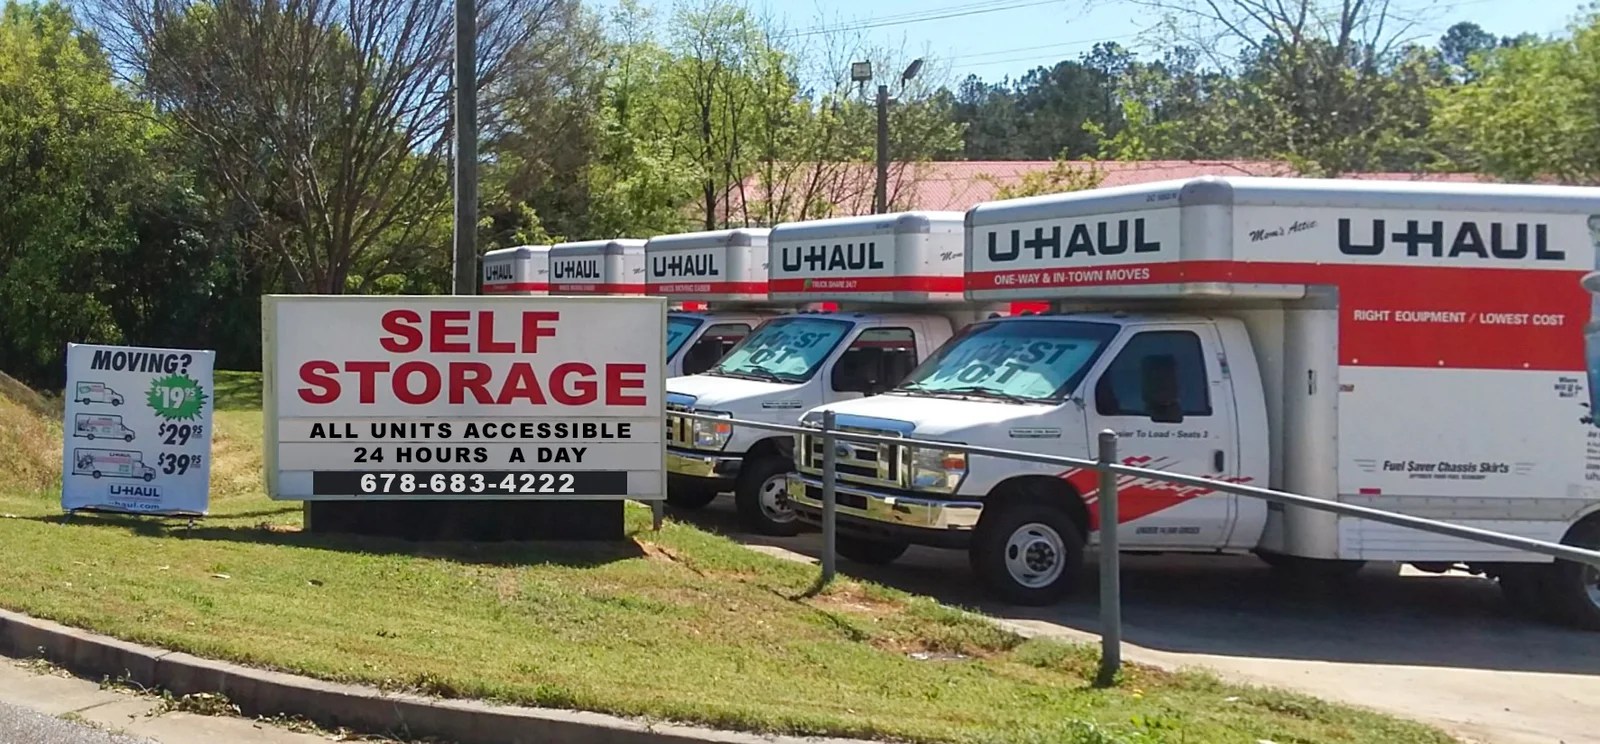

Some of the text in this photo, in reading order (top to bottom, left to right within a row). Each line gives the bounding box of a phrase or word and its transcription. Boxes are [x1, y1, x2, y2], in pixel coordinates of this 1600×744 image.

[988, 218, 1160, 262] U-HAUL
[1338, 218, 1565, 260] U-HAUL
[653, 254, 719, 277] U-HAUL
[782, 242, 883, 272] U-HAUL
[485, 263, 513, 281] U-HAUL
[555, 260, 600, 279] U-HAUL
[995, 268, 1150, 286] ONE-WAY & IN-TOWN MOVES
[1354, 309, 1390, 321] RIGHT
[1395, 310, 1466, 323] EQUIPMENT
[1480, 313, 1528, 325] LOWEST
[1533, 314, 1564, 325] COST
[379, 309, 559, 353] SELF
[91, 350, 192, 374] MOVING?
[297, 360, 647, 406] STORAGE
[310, 422, 632, 439] ALL UNITS ACCESSIBLE
[353, 447, 588, 463] 24 HOURS A DAY
[1383, 460, 1509, 473] Fuel Saver Chassis Skirts
[110, 485, 160, 497] U-HAUL
[360, 472, 576, 493] 678-683-4222
